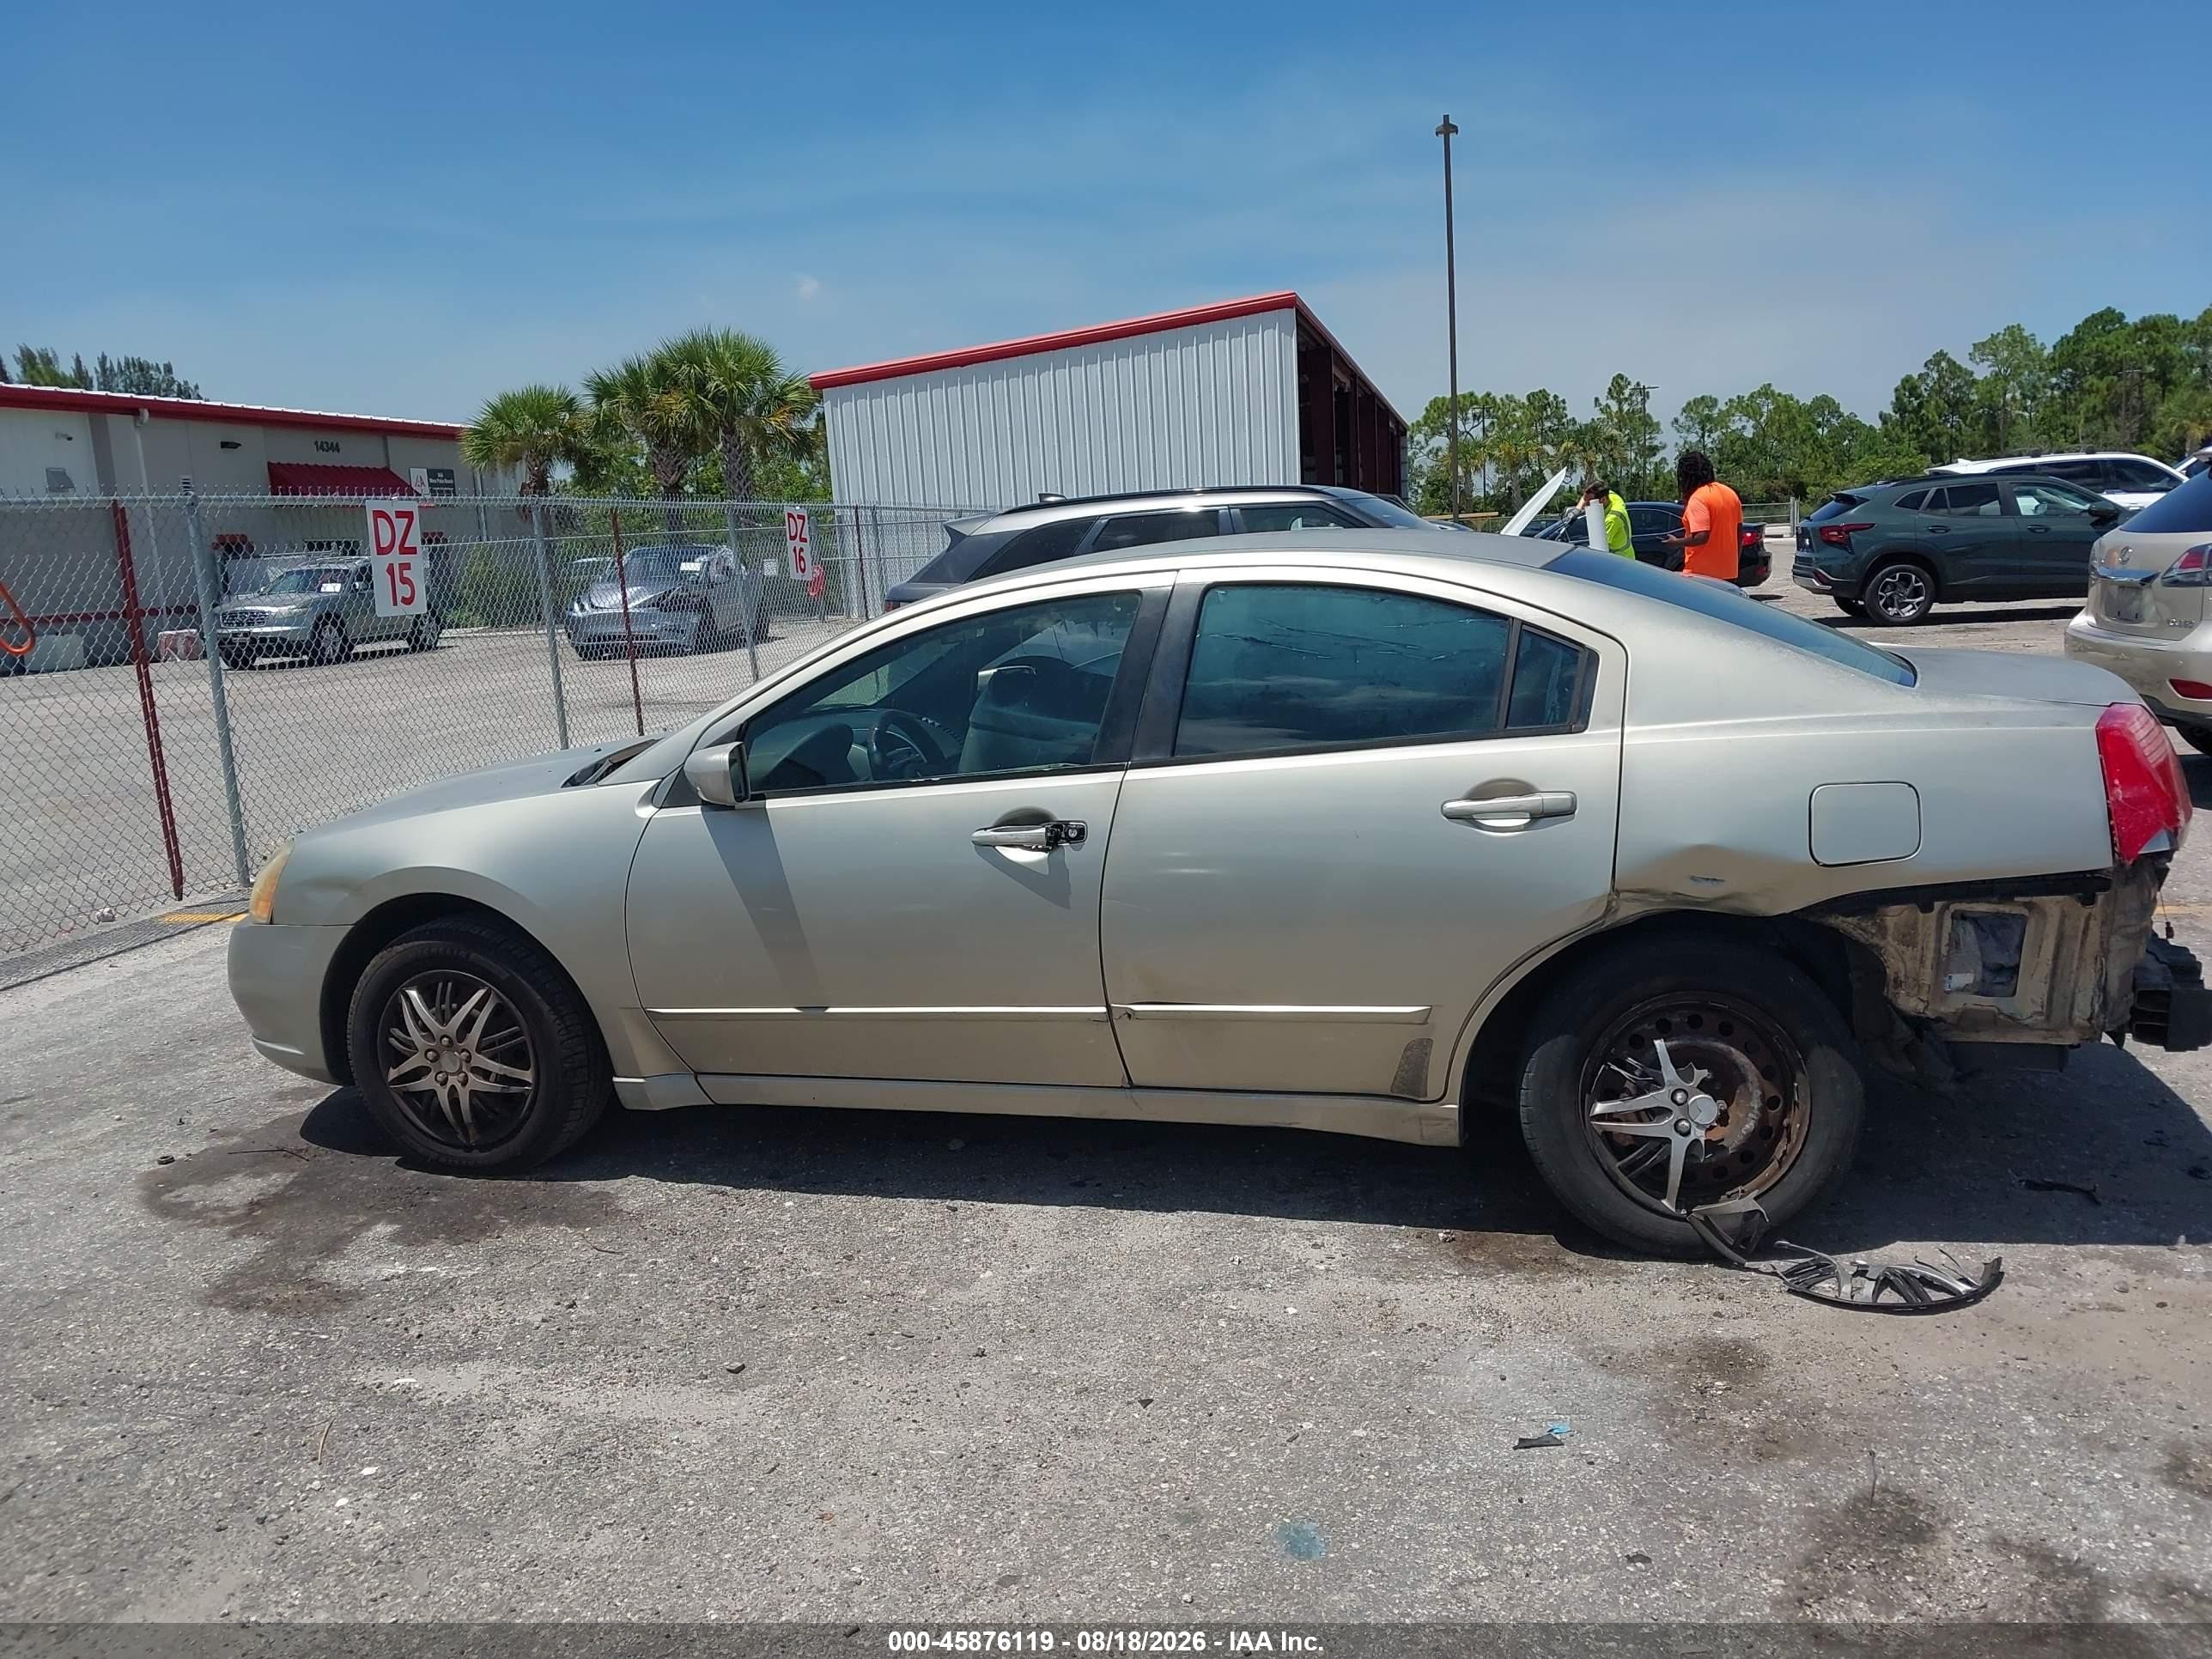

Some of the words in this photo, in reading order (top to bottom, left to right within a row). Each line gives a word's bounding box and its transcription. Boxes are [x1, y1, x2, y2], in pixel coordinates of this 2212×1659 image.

[313, 440, 340, 453] 14344
[372, 510, 417, 556] DZ
[787, 512, 808, 543] DZ
[793, 545, 806, 574] 16
[386, 562, 416, 606] 15
